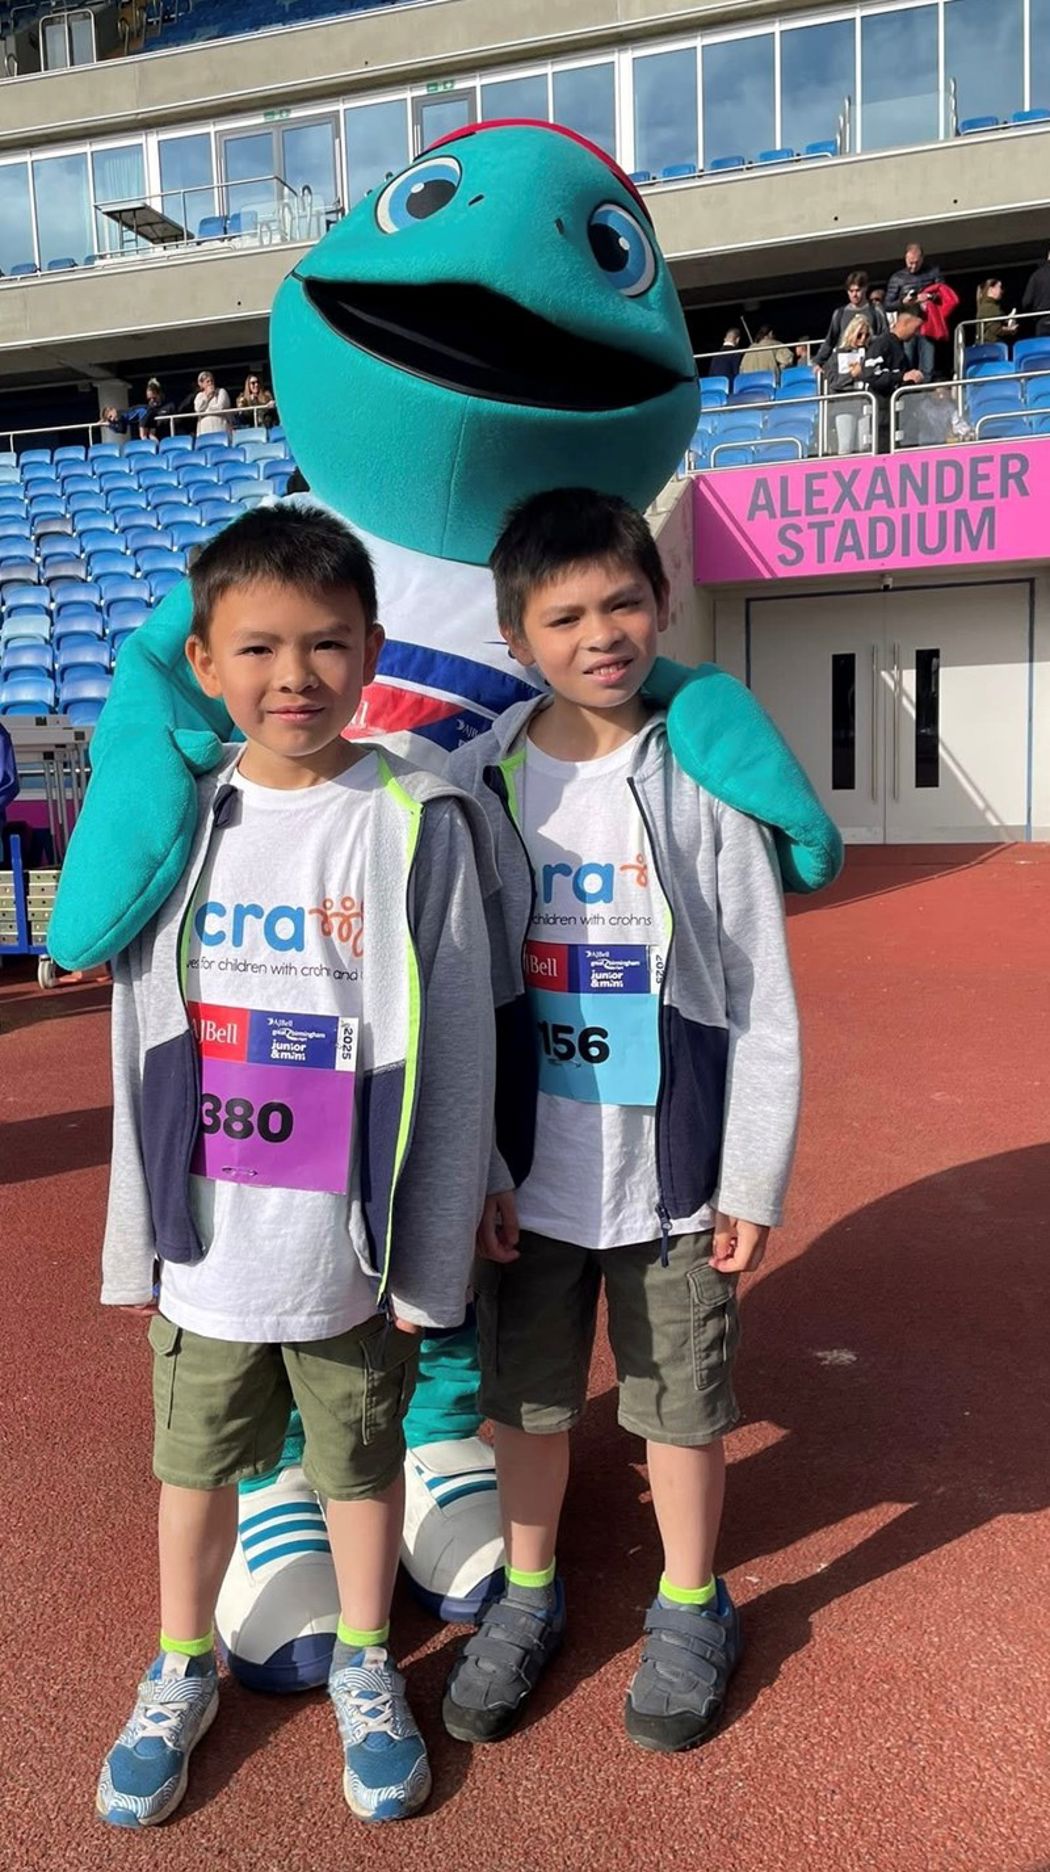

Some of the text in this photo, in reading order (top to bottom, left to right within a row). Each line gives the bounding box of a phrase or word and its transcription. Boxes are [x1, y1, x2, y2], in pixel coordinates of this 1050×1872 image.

[747, 453, 1030, 522] ALEXANDER
[777, 506, 996, 568] STADIUM
[195, 901, 305, 952] cra
[580, 913, 606, 926] with
[608, 913, 652, 926] crohns
[200, 956, 216, 969] for
[218, 957, 267, 974] children
[270, 961, 298, 976] with
[333, 968, 358, 981] and
[590, 969, 624, 980] junior
[271, 1038, 307, 1052] junior
[342, 1027, 354, 1060] 2025
[538, 1020, 610, 1064] 156
[202, 1093, 294, 1143] 380
